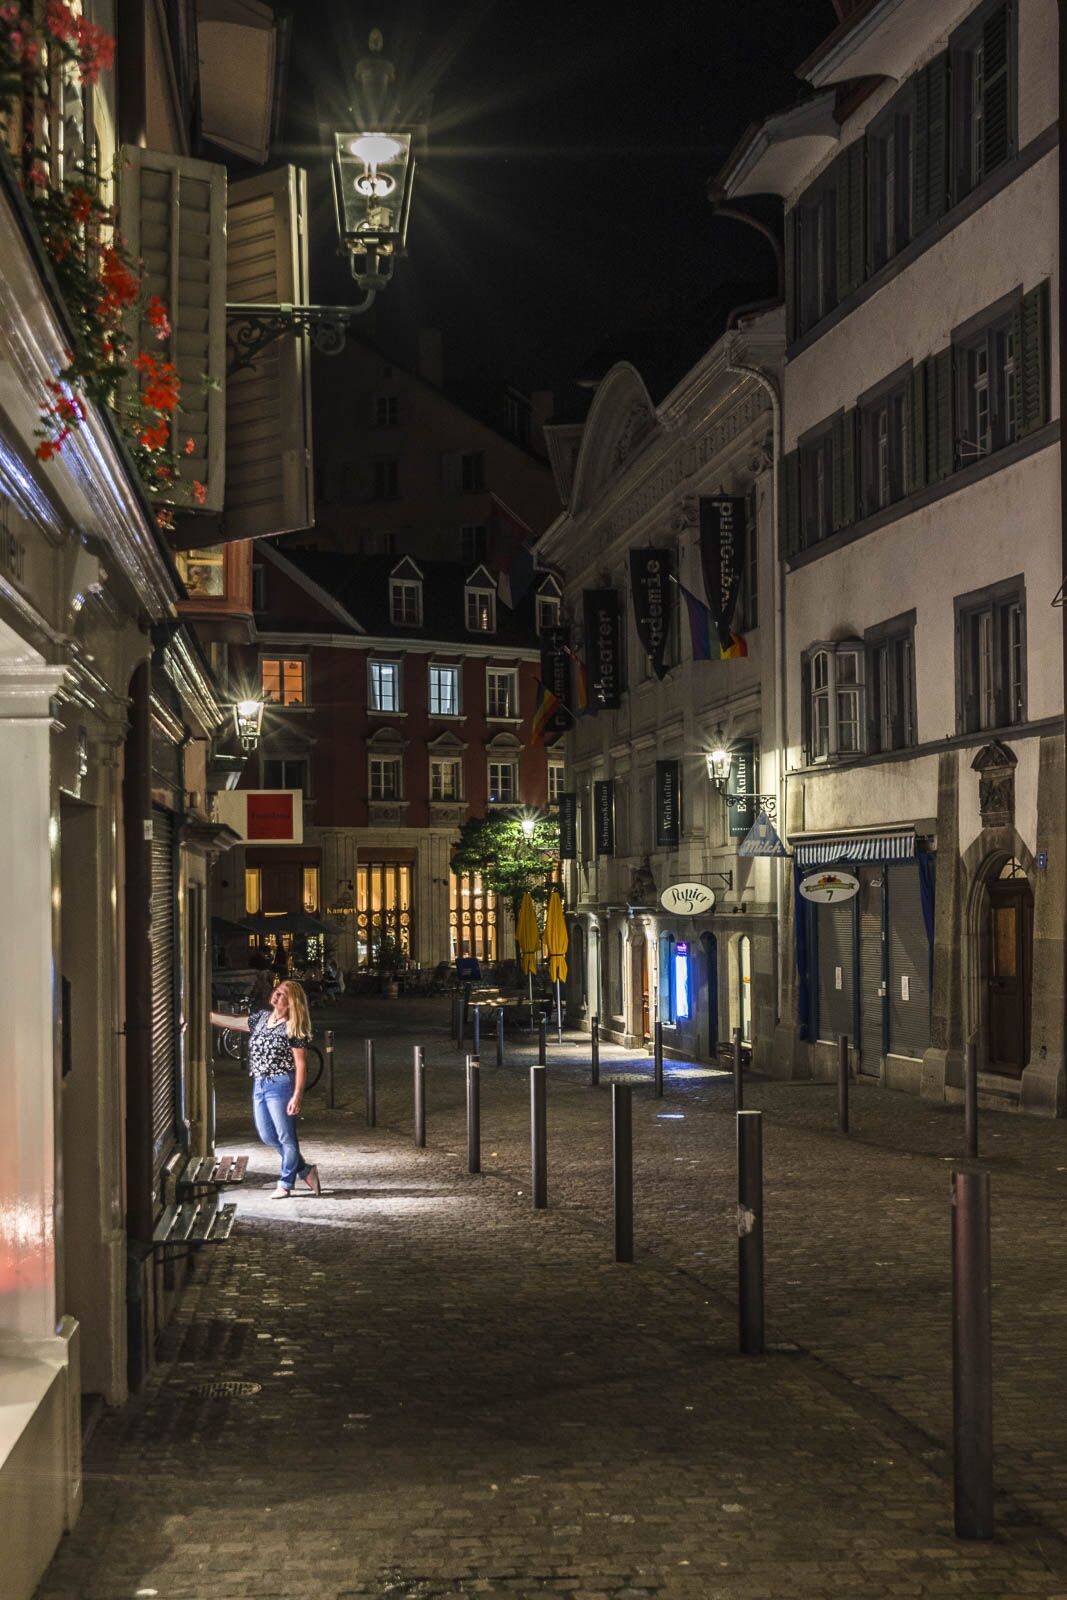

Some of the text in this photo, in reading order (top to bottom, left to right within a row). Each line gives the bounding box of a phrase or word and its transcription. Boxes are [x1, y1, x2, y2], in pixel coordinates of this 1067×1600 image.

[601, 785, 610, 847] SchnapsKultur
[663, 771, 673, 829] WeinKultur
[742, 839, 782, 854] Milch
[825, 889, 834, 902] 7
